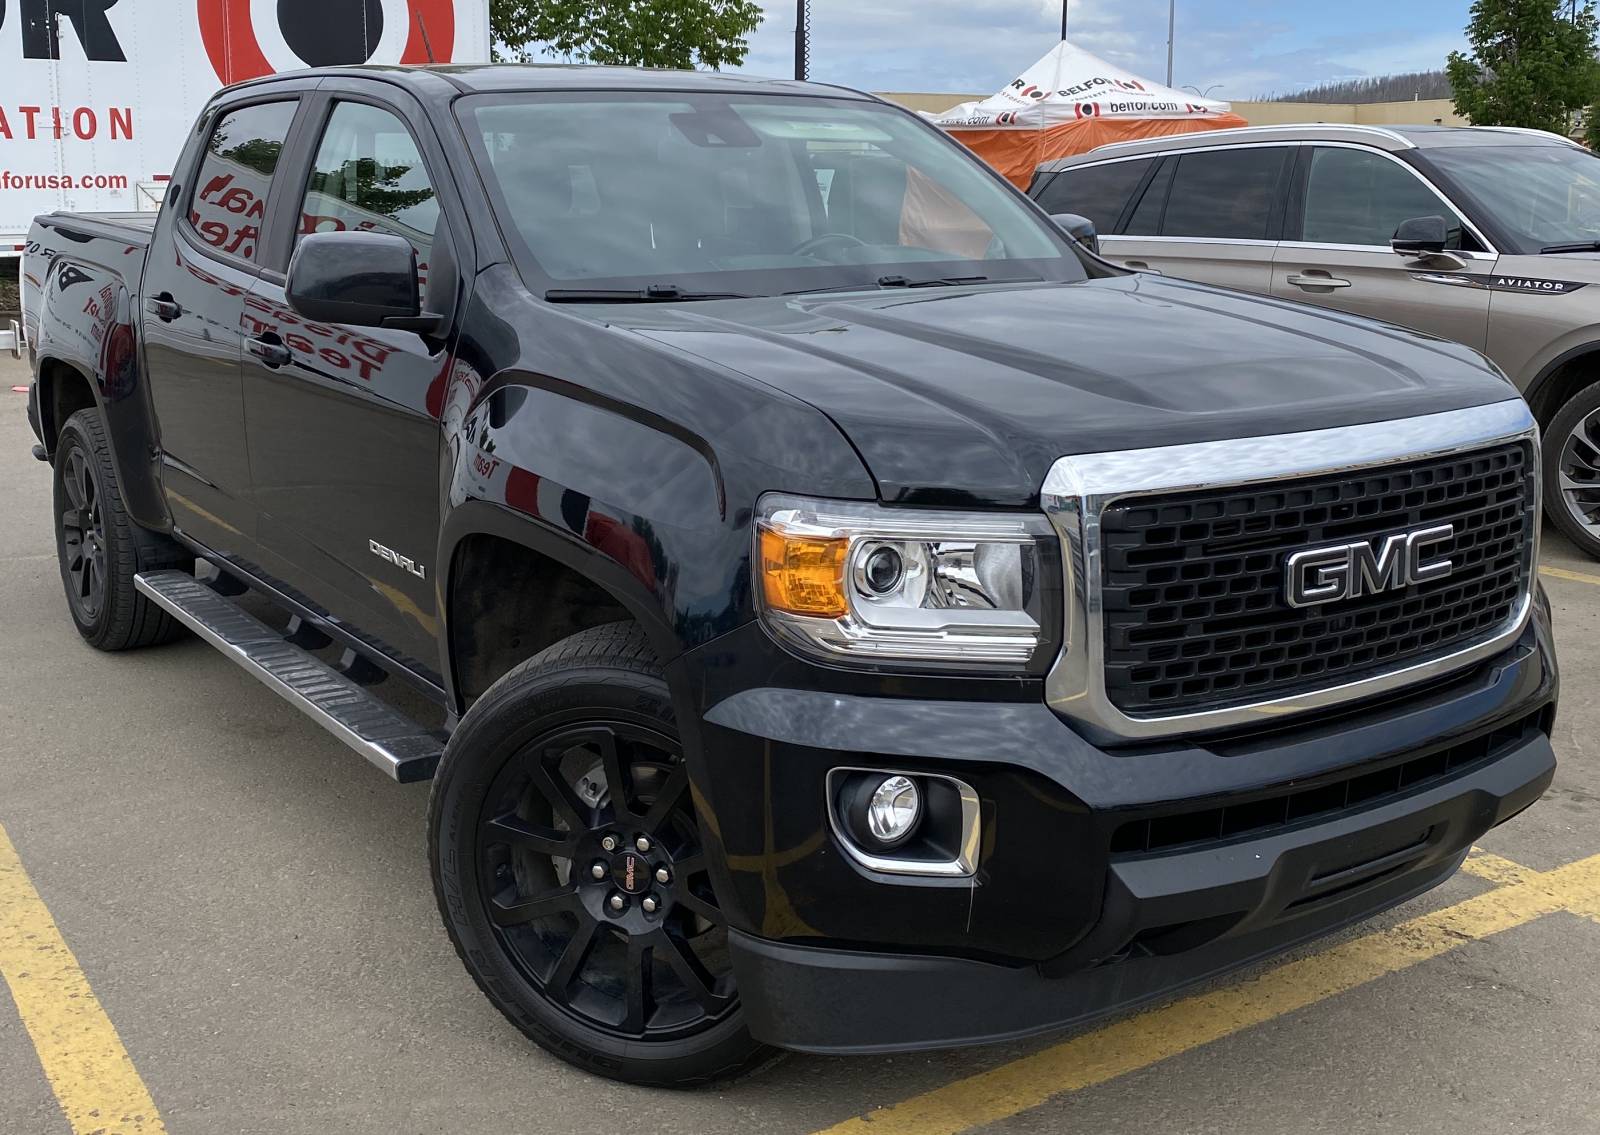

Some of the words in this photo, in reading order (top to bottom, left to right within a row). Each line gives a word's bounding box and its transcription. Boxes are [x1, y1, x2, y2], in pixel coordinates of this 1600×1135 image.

[1057, 77, 1115, 97] BELFOR
[0, 171, 128, 189] forusa.com
[1497, 278, 1564, 290] AVIATOR
[368, 538, 426, 581] DENALI
[1287, 524, 1454, 608] GMC
[626, 856, 635, 890] GMC
